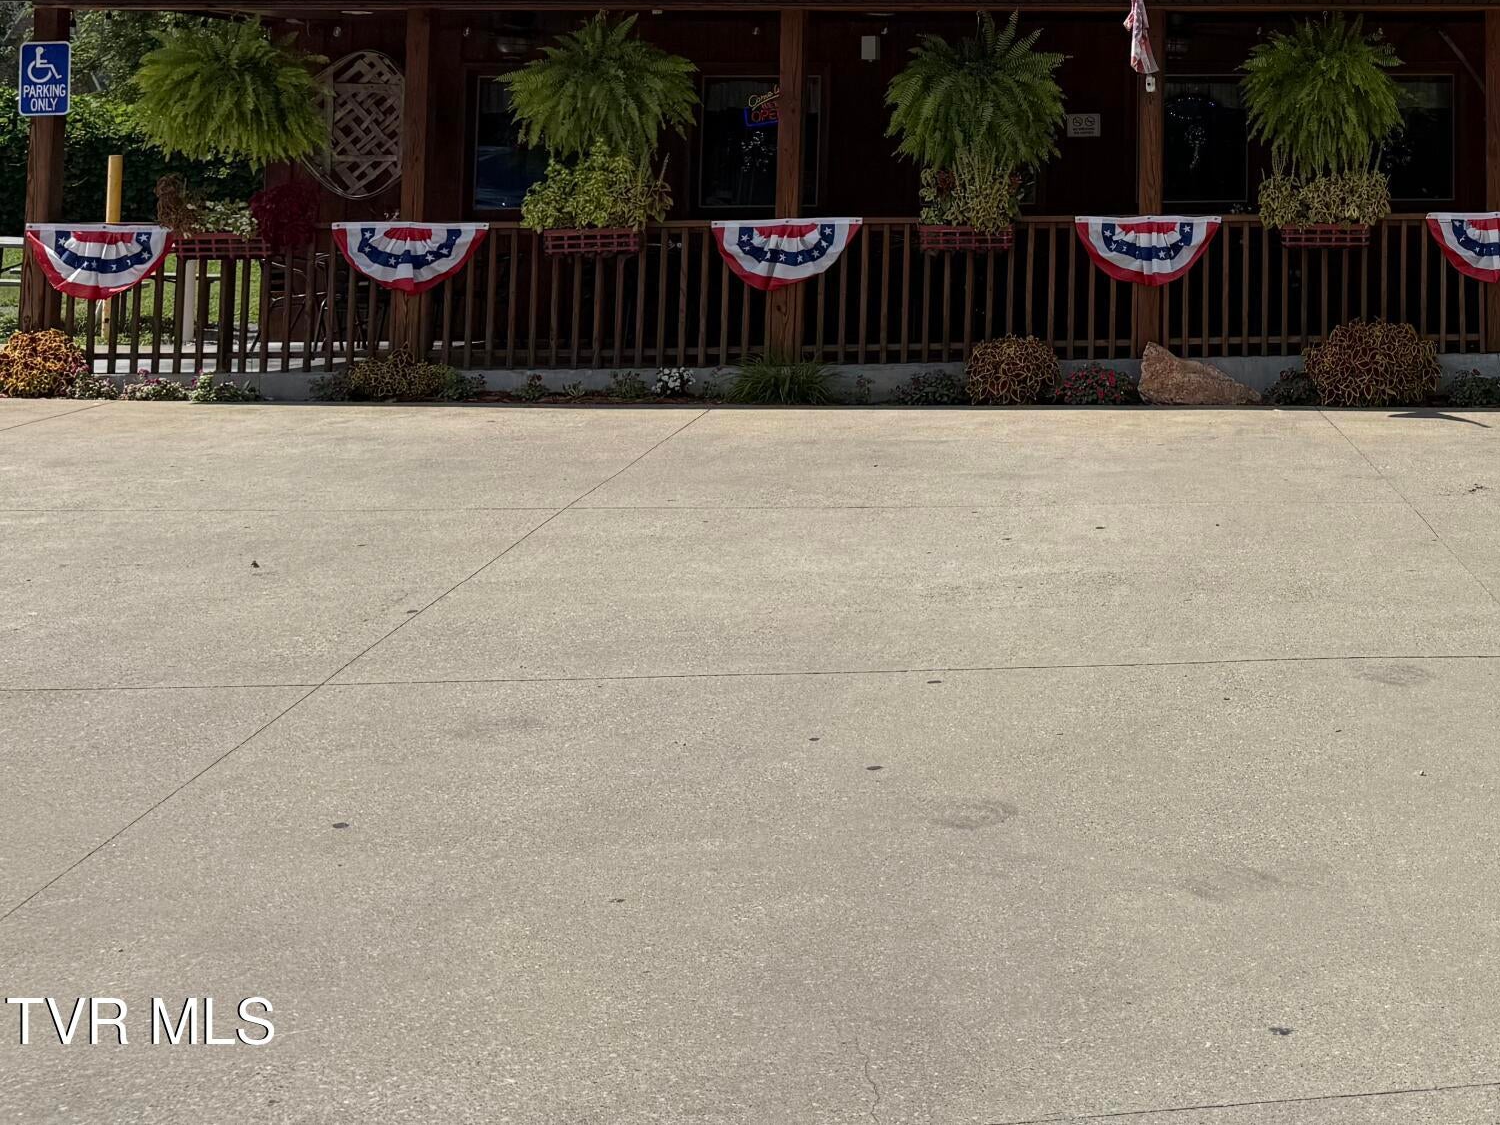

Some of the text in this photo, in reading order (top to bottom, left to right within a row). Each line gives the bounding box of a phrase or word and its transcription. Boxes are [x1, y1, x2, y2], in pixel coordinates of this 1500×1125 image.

[23, 83, 66, 98] PARKING
[30, 97, 58, 112] ONLY
[751, 108, 777, 123] OPE
